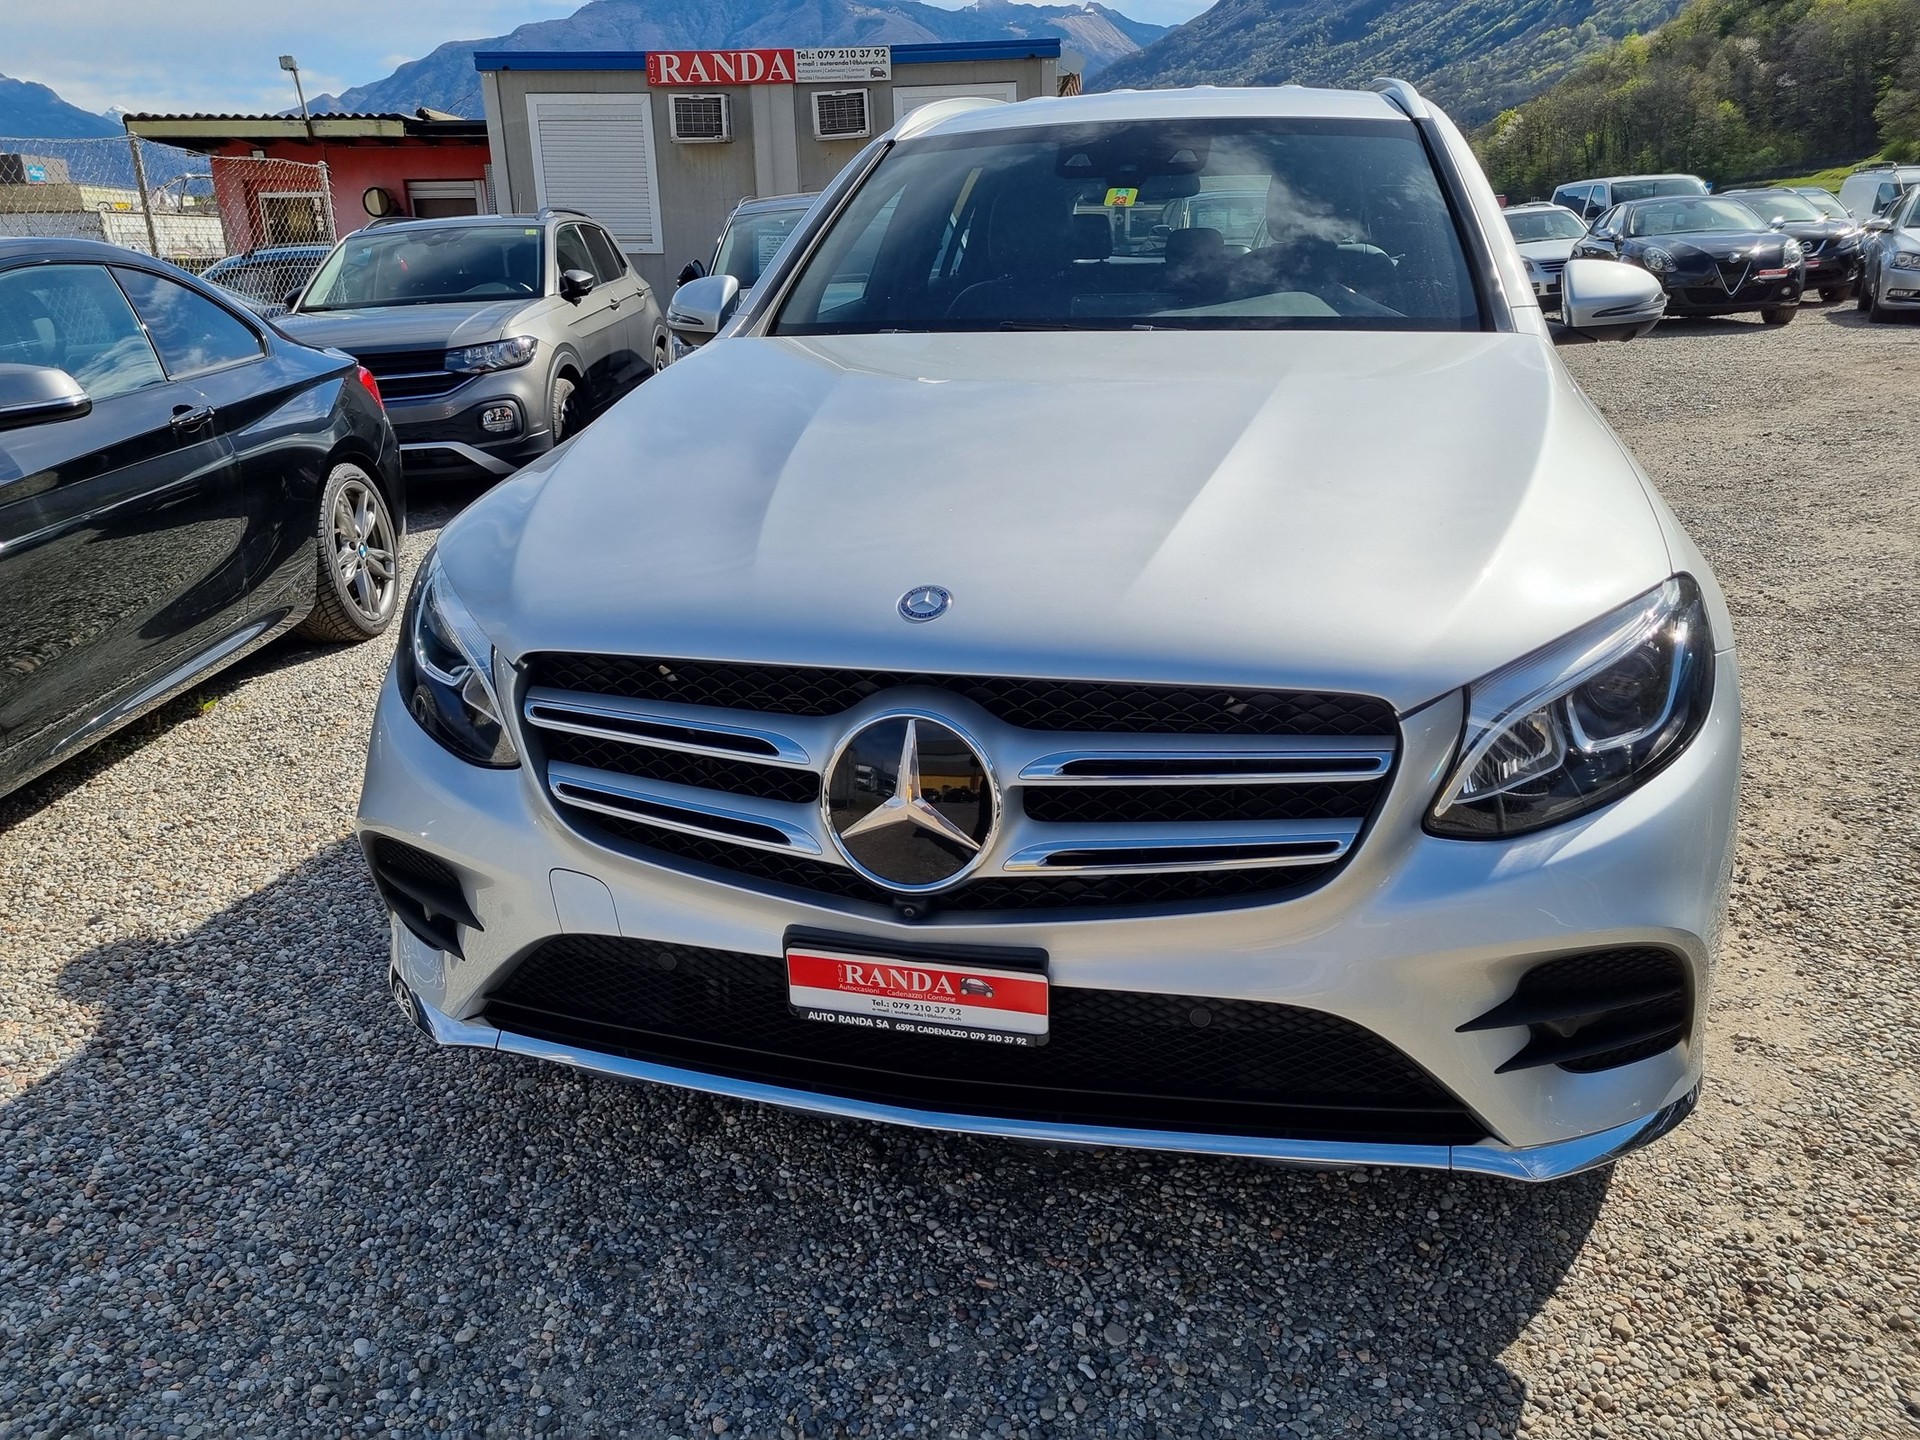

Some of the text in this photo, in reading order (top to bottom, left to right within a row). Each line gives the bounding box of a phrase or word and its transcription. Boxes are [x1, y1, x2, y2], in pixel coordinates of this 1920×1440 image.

[796, 48, 886, 60] Tel.: 079 210 37 92
[648, 55, 657, 84] AUTO
[656, 51, 793, 84] RANDA
[1112, 196, 1127, 204] 23
[844, 963, 955, 995] RANDA
[838, 983, 956, 1003] Autoccasioni Cadenazzo Contone
[871, 999, 962, 1016] Tel.: 079 210 37 92
[807, 1011, 1027, 1046] AUTO RANDA SA 6593 CADENAZZO 079 210 37 92
